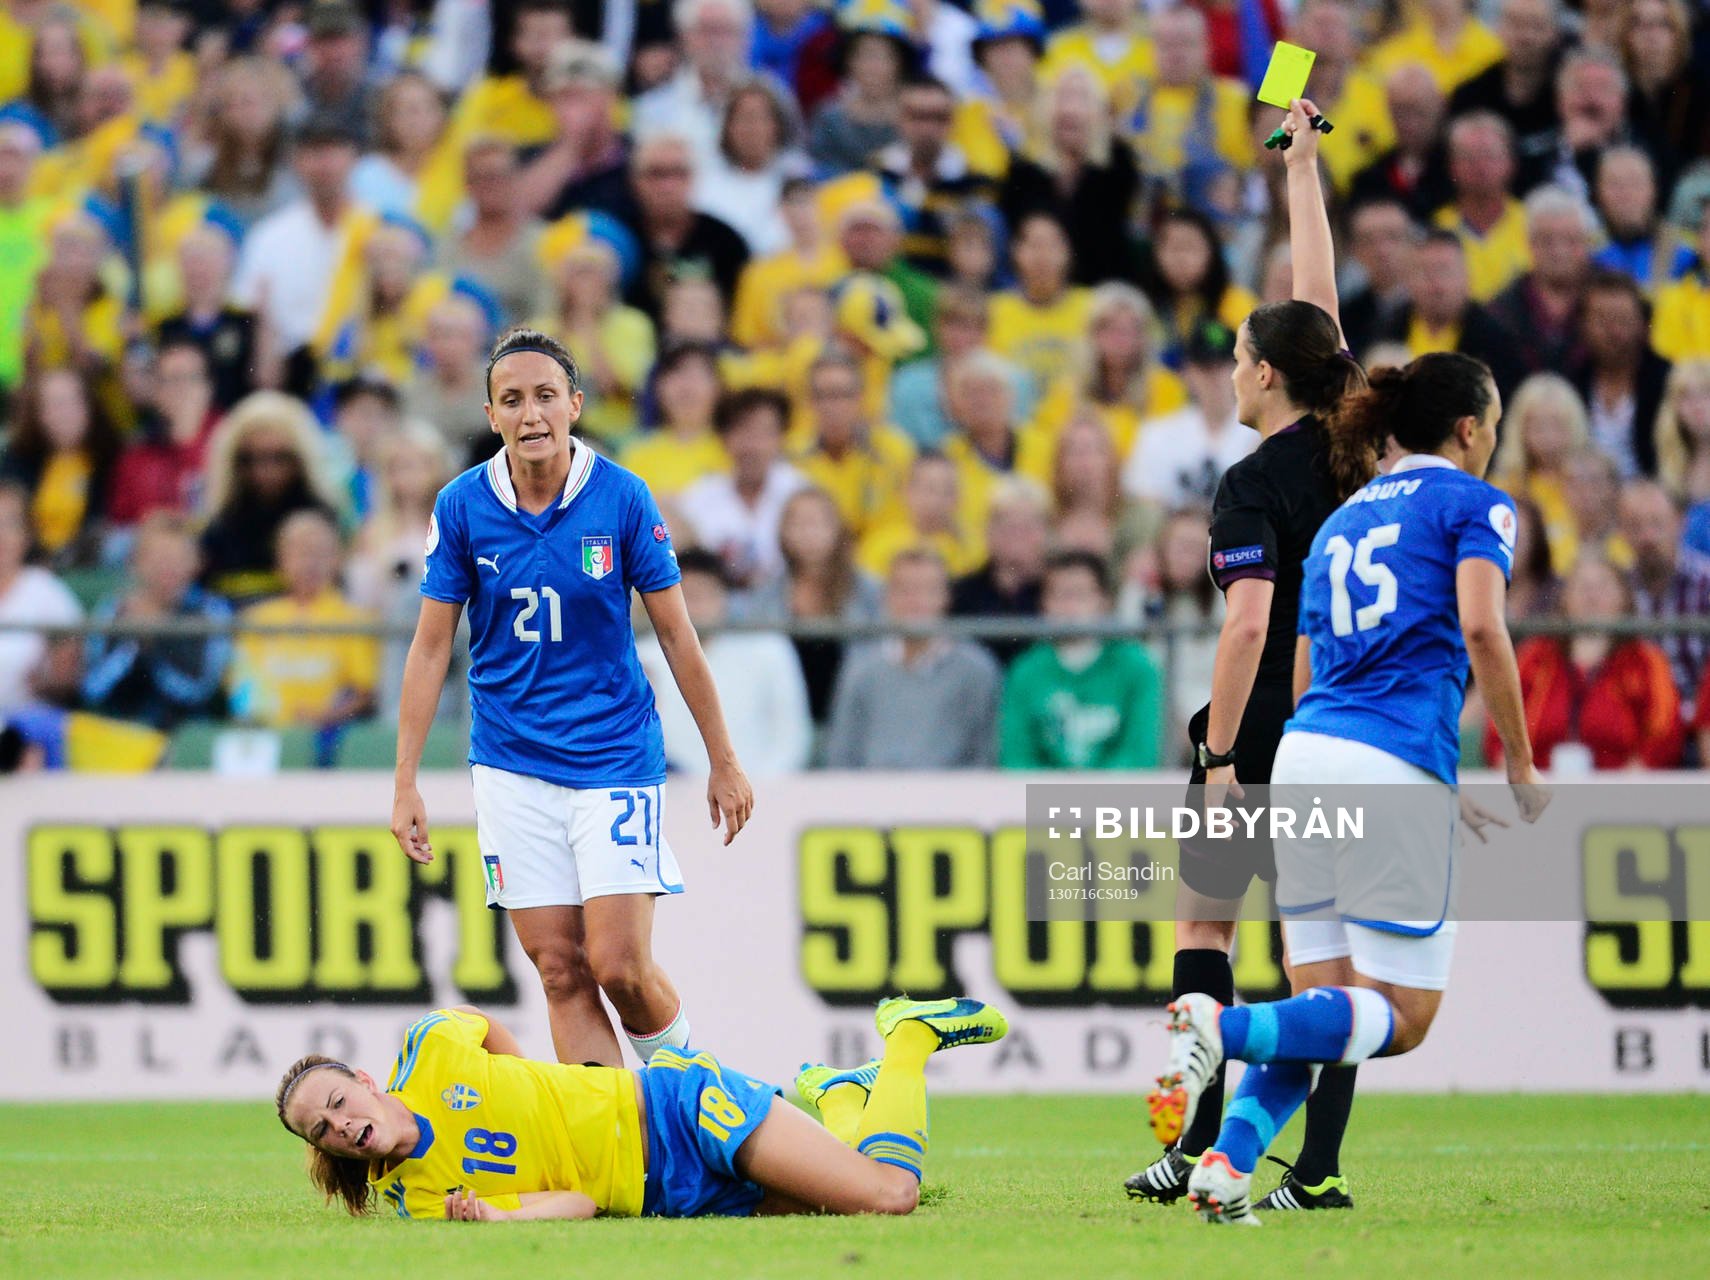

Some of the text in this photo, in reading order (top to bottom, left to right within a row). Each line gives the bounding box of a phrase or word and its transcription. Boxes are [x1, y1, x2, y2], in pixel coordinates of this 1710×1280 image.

[1225, 549, 1263, 563] RESPECT
[1324, 522, 1402, 638] 15
[510, 586, 563, 642] 21
[609, 790, 652, 846] 21
[26, 824, 510, 996] SPORT
[698, 1085, 747, 1143] 18
[462, 1127, 518, 1176] 18
